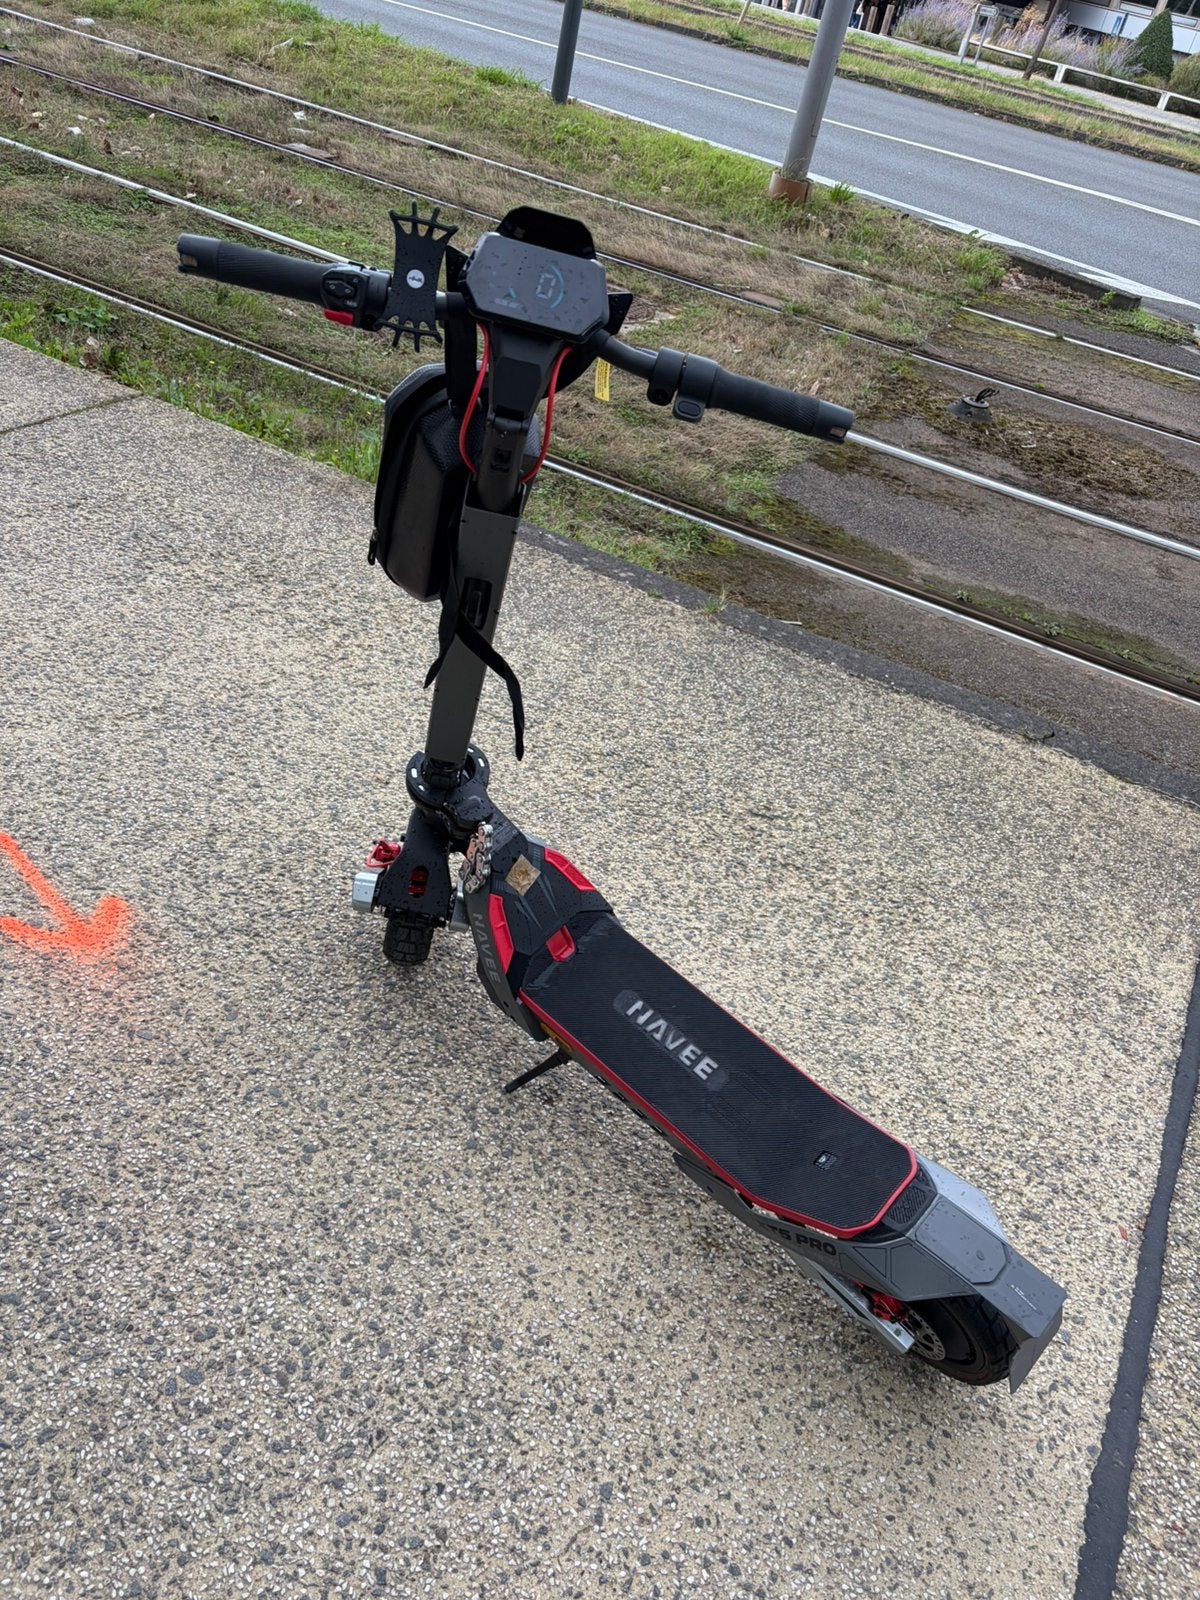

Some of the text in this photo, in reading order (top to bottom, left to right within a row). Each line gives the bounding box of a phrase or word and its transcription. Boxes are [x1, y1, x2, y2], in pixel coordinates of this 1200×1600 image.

[473, 913, 502, 982] NAVEE
[626, 1000, 719, 1081] NAVEE
[795, 1232, 837, 1256] PRO
